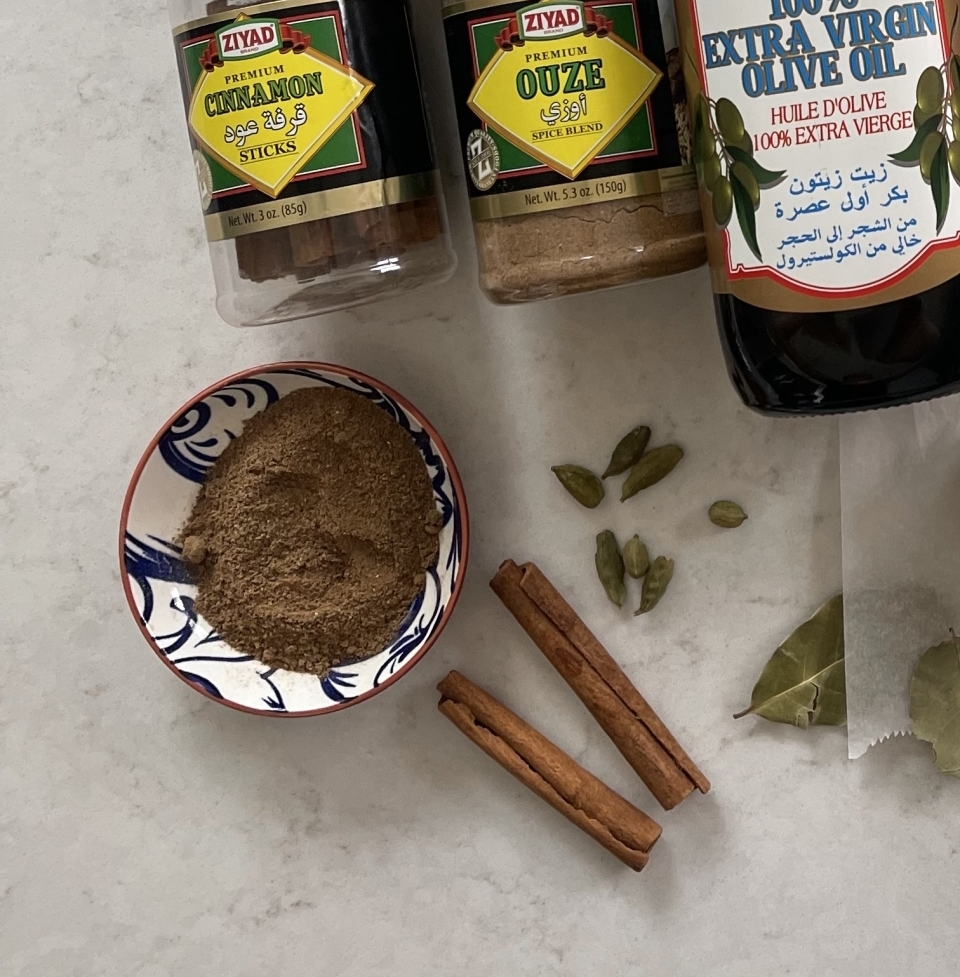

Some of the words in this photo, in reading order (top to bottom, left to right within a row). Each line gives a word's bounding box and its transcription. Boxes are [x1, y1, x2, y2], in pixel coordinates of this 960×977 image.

[524, 9, 580, 33] ZIYAD
[222, 26, 274, 53] ZIYAD
[702, 19, 815, 69] EXTRA
[820, 1, 938, 49] VIRGIN
[525, 46, 588, 63] PREMIUM
[224, 65, 284, 84] PREMIUM
[516, 58, 606, 100] OUZE
[741, 50, 843, 98] OLIVE
[850, 42, 906, 81] OIL
[204, 72, 324, 117] CINNAMON
[262, 103, 308, 137] قرفة
[540, 93, 588, 125] أوزي
[771, 101, 820, 125] HUILE
[824, 91, 887, 117] D'OLIVE
[224, 120, 258, 147] عود
[532, 129, 564, 141] SPICE
[566, 123, 603, 135] BLEND
[753, 129, 792, 151] 100%
[795, 120, 850, 145] EXTRA
[854, 111, 914, 135] VIERGE
[240, 141, 296, 162] STICKS
[789, 170, 842, 195] زيتون
[850, 163, 888, 185] زيت
[525, 194, 542, 205] Net.
[544, 191, 560, 203] Wt.
[562, 187, 578, 199] 5.3
[580, 187, 594, 197] oz.
[596, 179, 626, 197] (150g)
[841, 183, 870, 211] أول
[880, 185, 908, 207] بكر
[260, 210, 264, 221] 3
[266, 209, 279, 219] oz.
[282, 201, 307, 217] (85g)
[774, 199, 830, 221] عصرة
[826, 225, 842, 243] إلى
[847, 217, 892, 239] الشجر
[896, 217, 917, 232] من
[776, 228, 822, 250] الحجر
[866, 242, 887, 257] من
[892, 233, 922, 255] خالي
[776, 243, 862, 269] الكولستيرول
